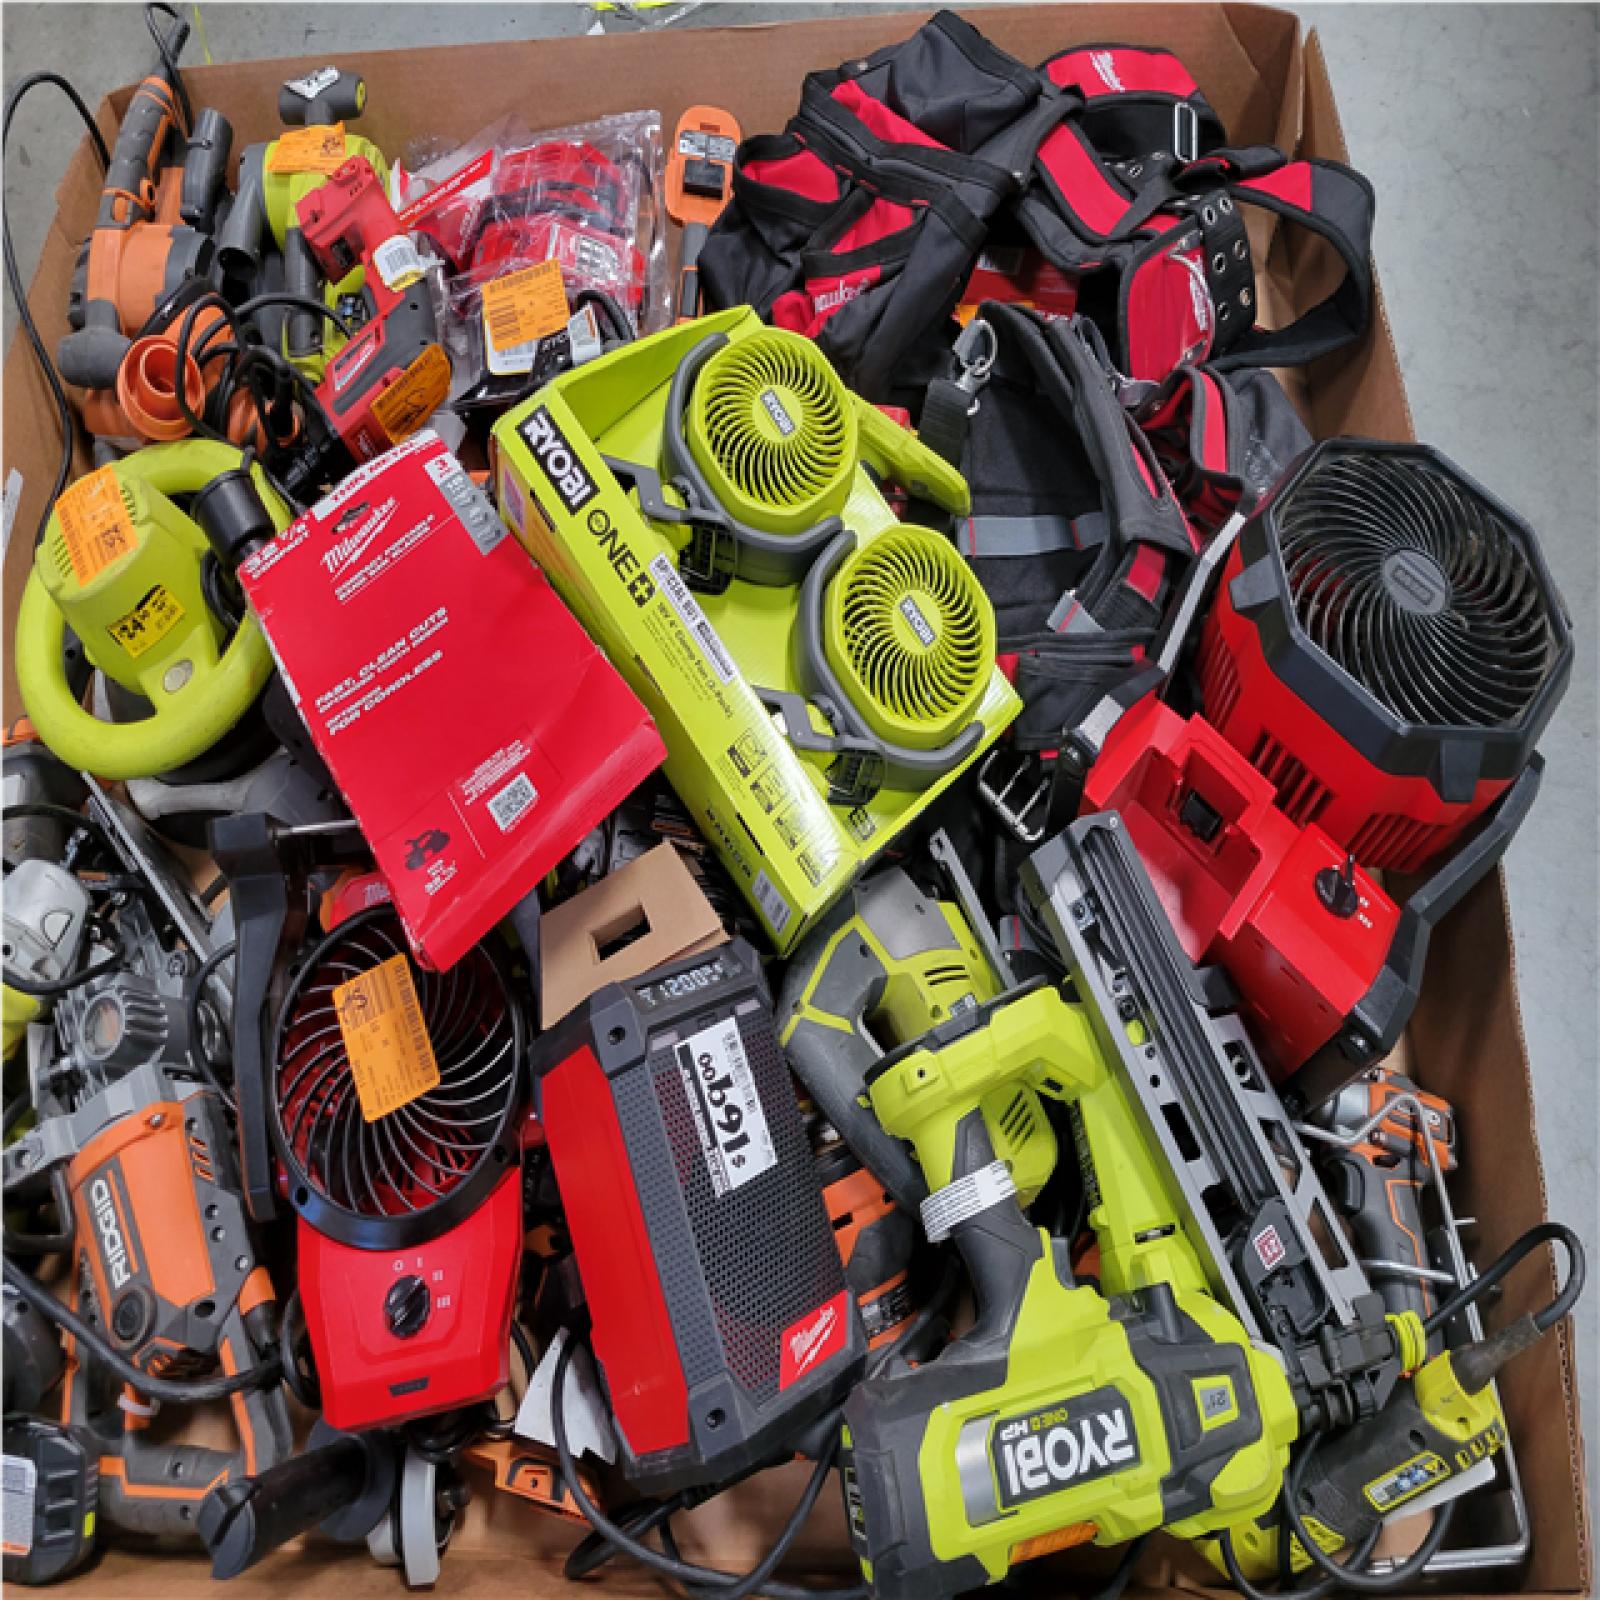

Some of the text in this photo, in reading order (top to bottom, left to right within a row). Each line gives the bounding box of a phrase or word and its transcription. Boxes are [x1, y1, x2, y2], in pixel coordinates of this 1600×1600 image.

[761, 390, 794, 435] RYOBI
[525, 412, 591, 506] RYOBI
[321, 496, 398, 580] Milwaukee
[358, 638, 407, 677] CLEAN
[410, 607, 447, 640] CUTS
[672, 629, 698, 663] Clamp
[692, 659, 710, 682] Fan
[900, 598, 935, 644] RYOBI
[328, 649, 444, 736] FOR CORDLESS
[91, 1178, 131, 1290] RIDGID
[1001, 1418, 1029, 1440] HP
[1002, 1407, 1135, 1497] RYOBI
